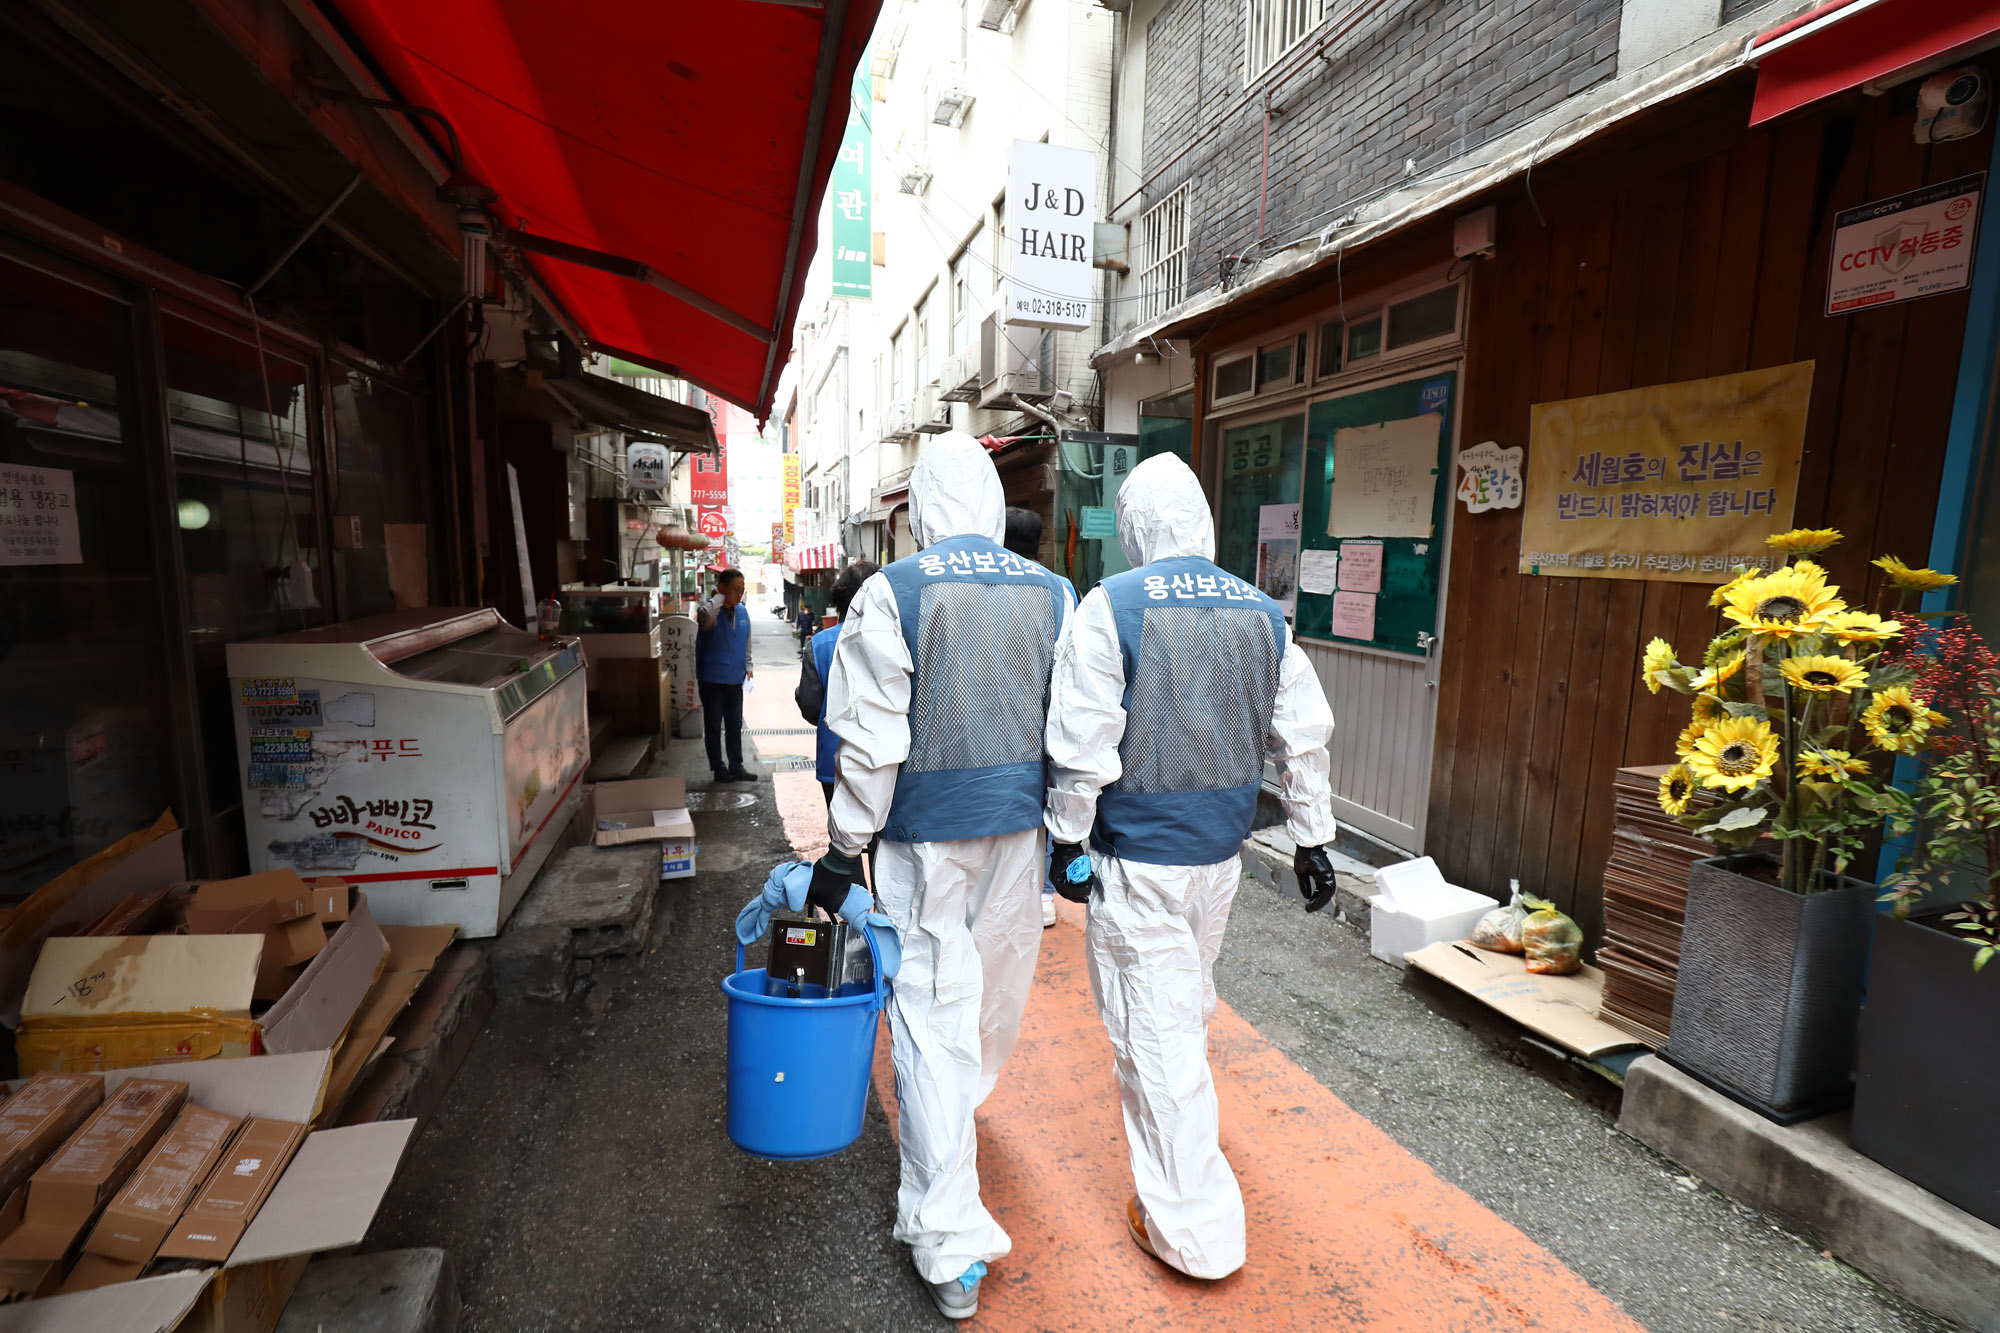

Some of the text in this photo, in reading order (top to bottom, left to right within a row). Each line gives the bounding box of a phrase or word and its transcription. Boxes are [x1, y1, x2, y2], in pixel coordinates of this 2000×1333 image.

[1873, 201, 1902, 215] CCTV
[1019, 227, 1088, 263] HAIR
[1840, 242, 1896, 272] CCTV
[1899, 225, 1964, 257] 작동중
[1033, 299, 1088, 318] 02-318-5137
[632, 457, 664, 471] Asahi
[1572, 440, 1764, 488] 세월호의 진실은
[692, 490, 727, 500] 777-5558
[1461, 467, 1511, 505] 식도락
[30, 489, 72, 510] 냉장고
[1558, 488, 1778, 520] 반드시 밝혀져야 합니다
[918, 550, 1046, 577] 용산보건소
[1528, 551, 1569, 567] 용산지역
[1644, 554, 1696, 571] 추모행사
[1144, 573, 1263, 603] 용산보건소
[309, 795, 437, 830] 빠삐코
[365, 820, 421, 840] PAPICO
[380, 852, 399, 863] 1981
